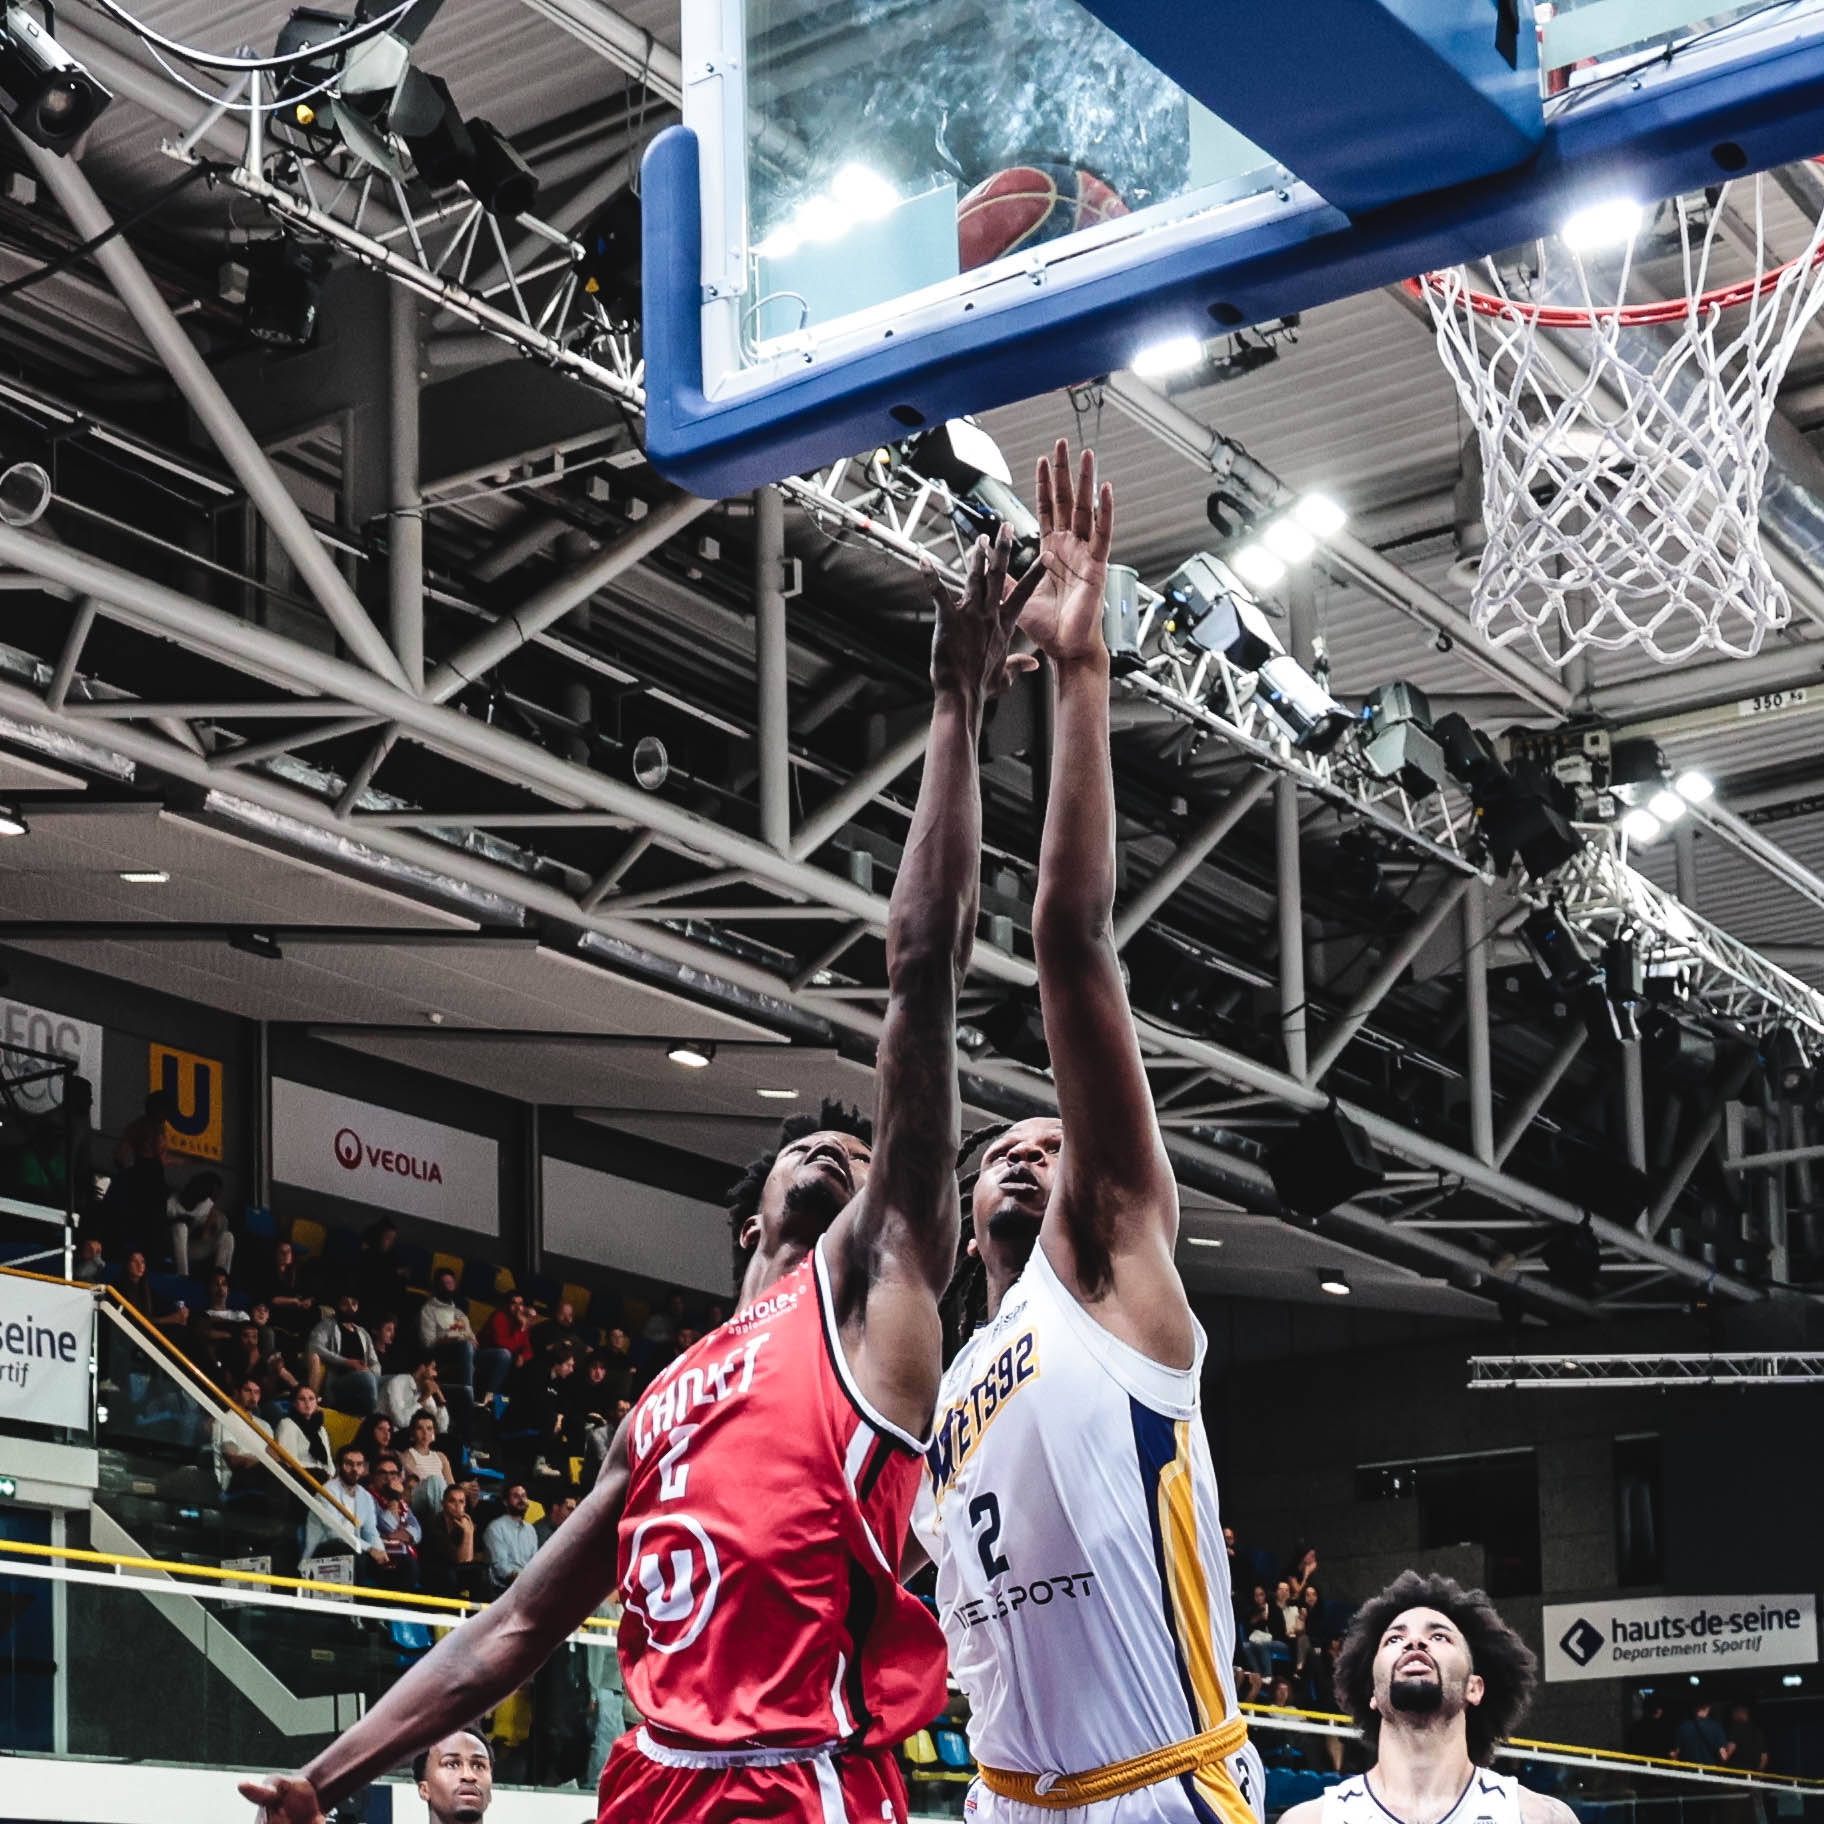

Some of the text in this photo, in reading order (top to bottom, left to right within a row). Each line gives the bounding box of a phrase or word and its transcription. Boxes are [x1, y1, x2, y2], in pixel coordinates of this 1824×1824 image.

[162, 1053, 211, 1136] U
[366, 1144, 444, 1185] VEOLIA
[657, 1423, 701, 1502] 2
[968, 1491, 1011, 1582] 2
[1711, 1635, 1762, 1655] Sportif
